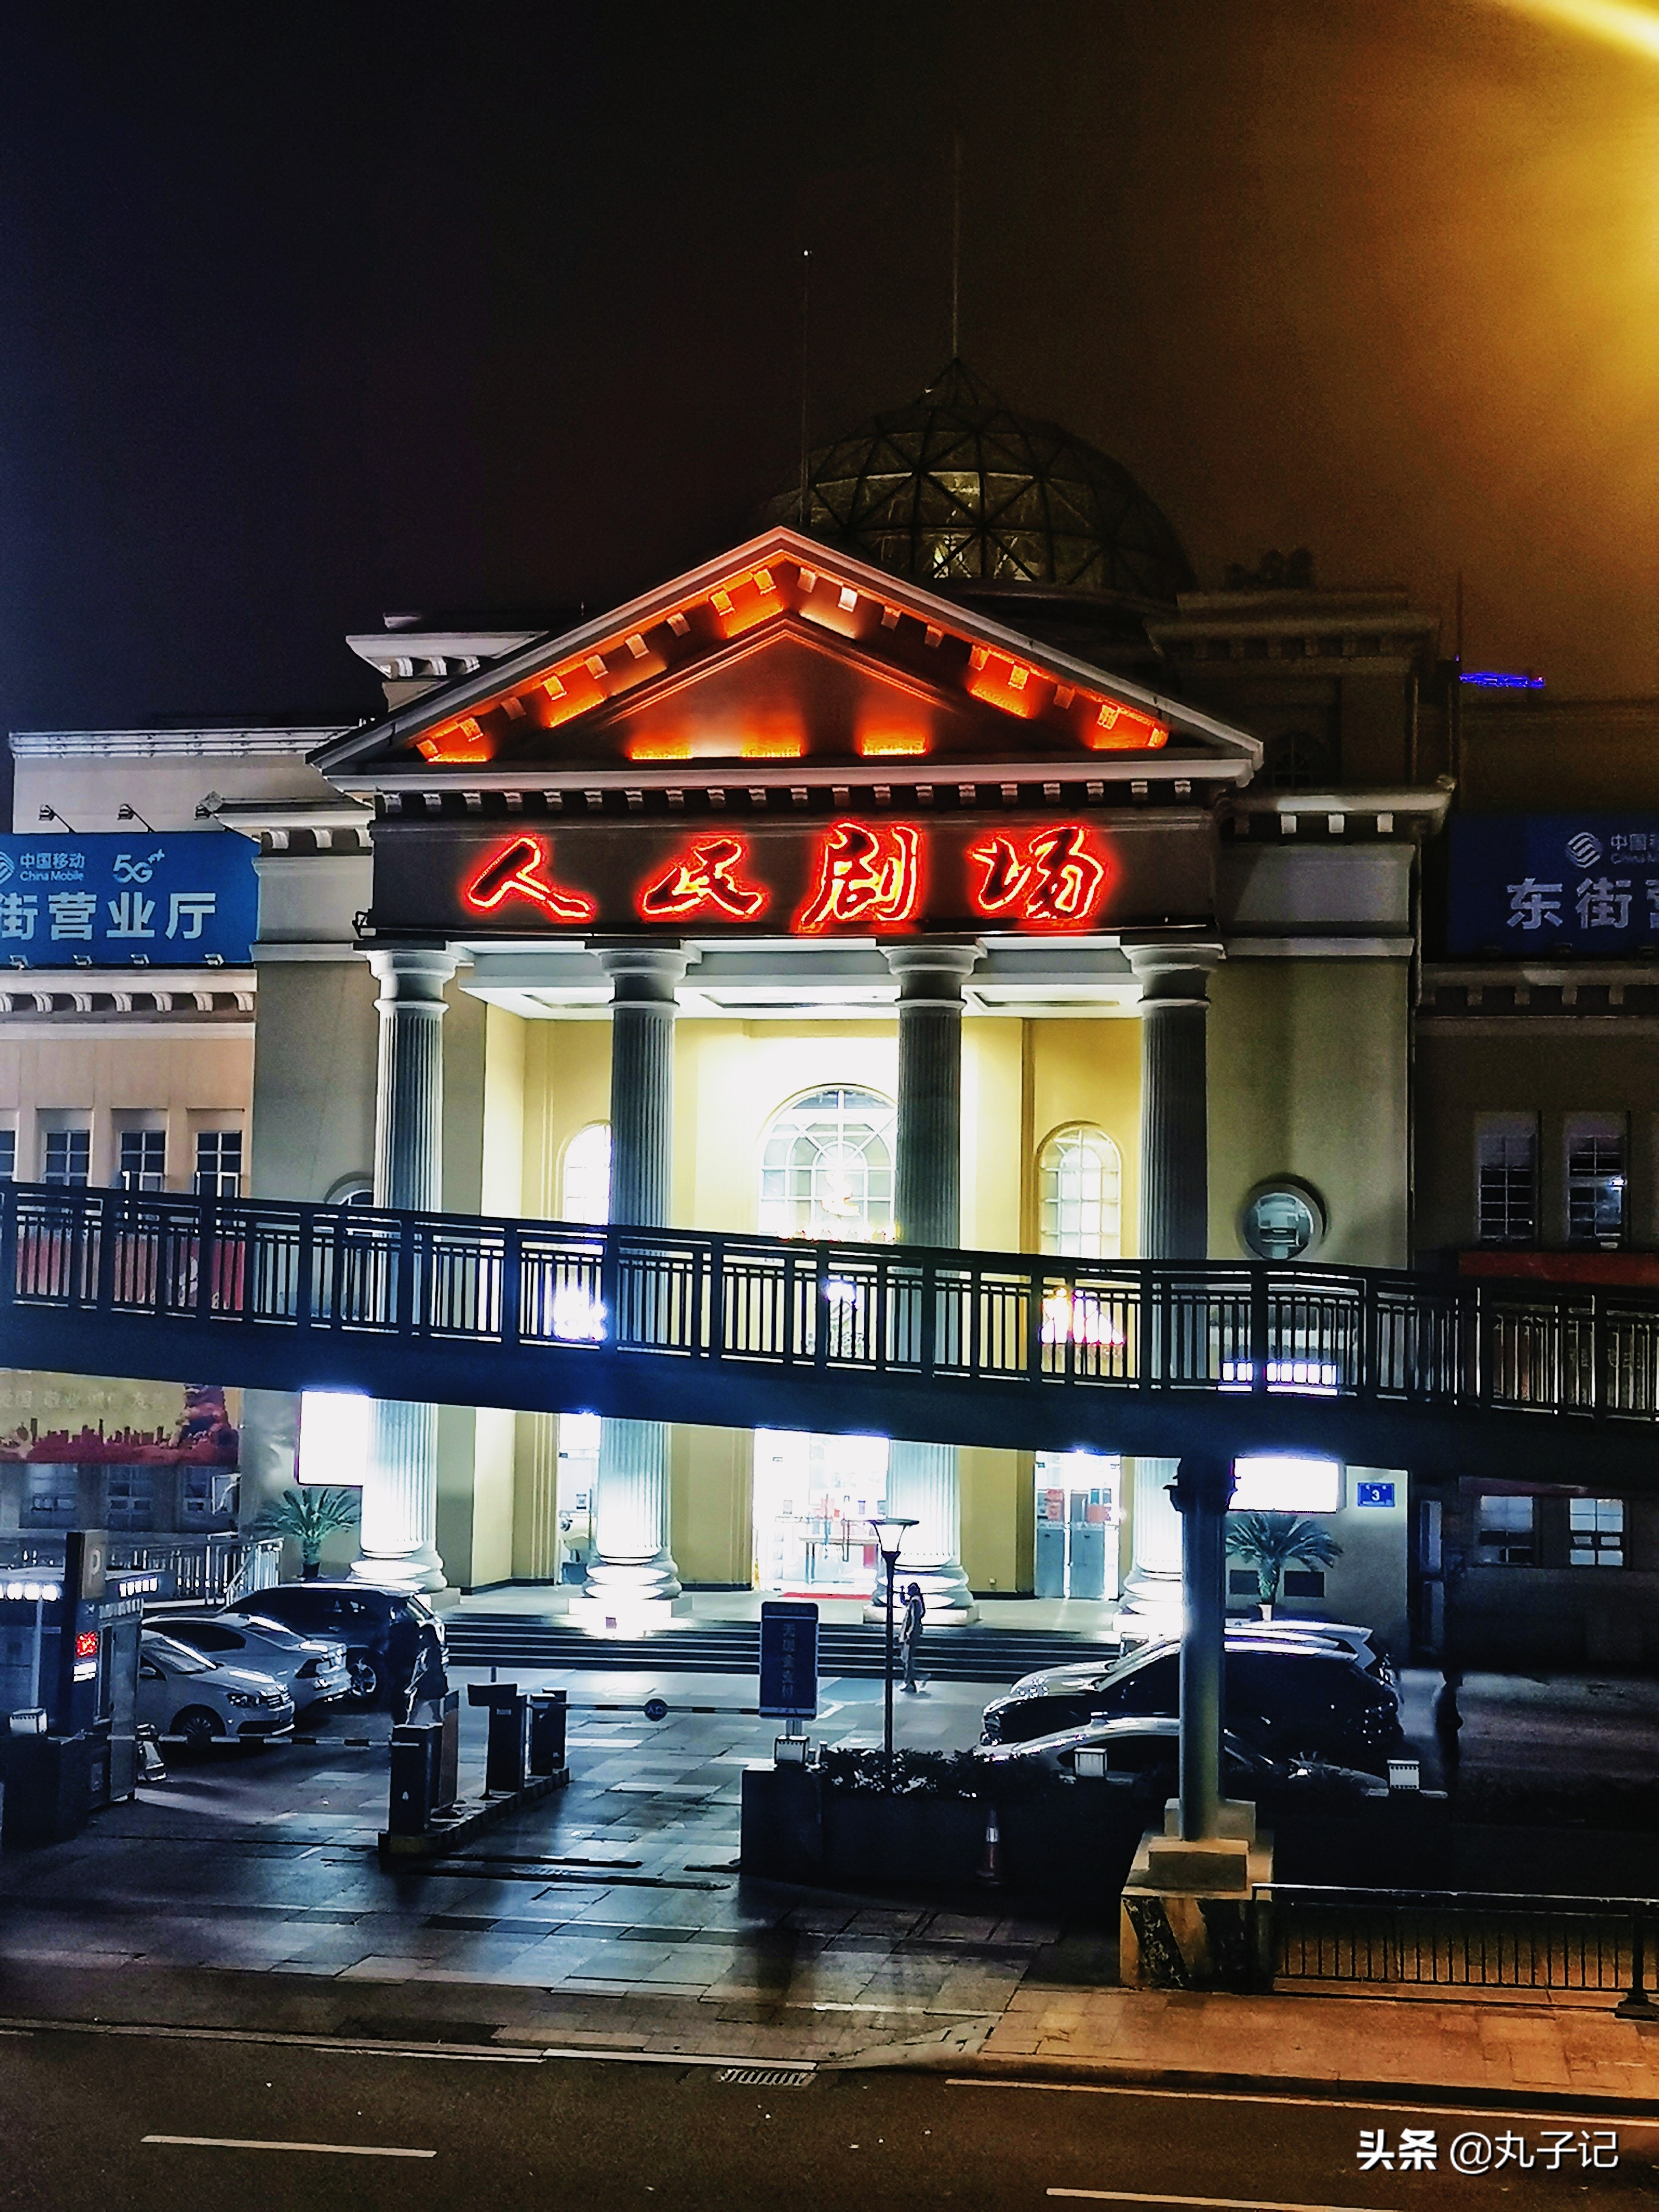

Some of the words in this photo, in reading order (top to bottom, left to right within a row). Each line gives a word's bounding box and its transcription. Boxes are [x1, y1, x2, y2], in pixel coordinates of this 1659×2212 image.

[20, 853, 85, 869] 中国移动
[20, 871, 50, 881] China
[51, 871, 84, 881] Mobile
[469, 820, 1105, 928] 人民剧场
[0, 891, 216, 940] 街营业厅
[1506, 877, 1659, 930] 东街
[1371, 1489, 1380, 1501] 3
